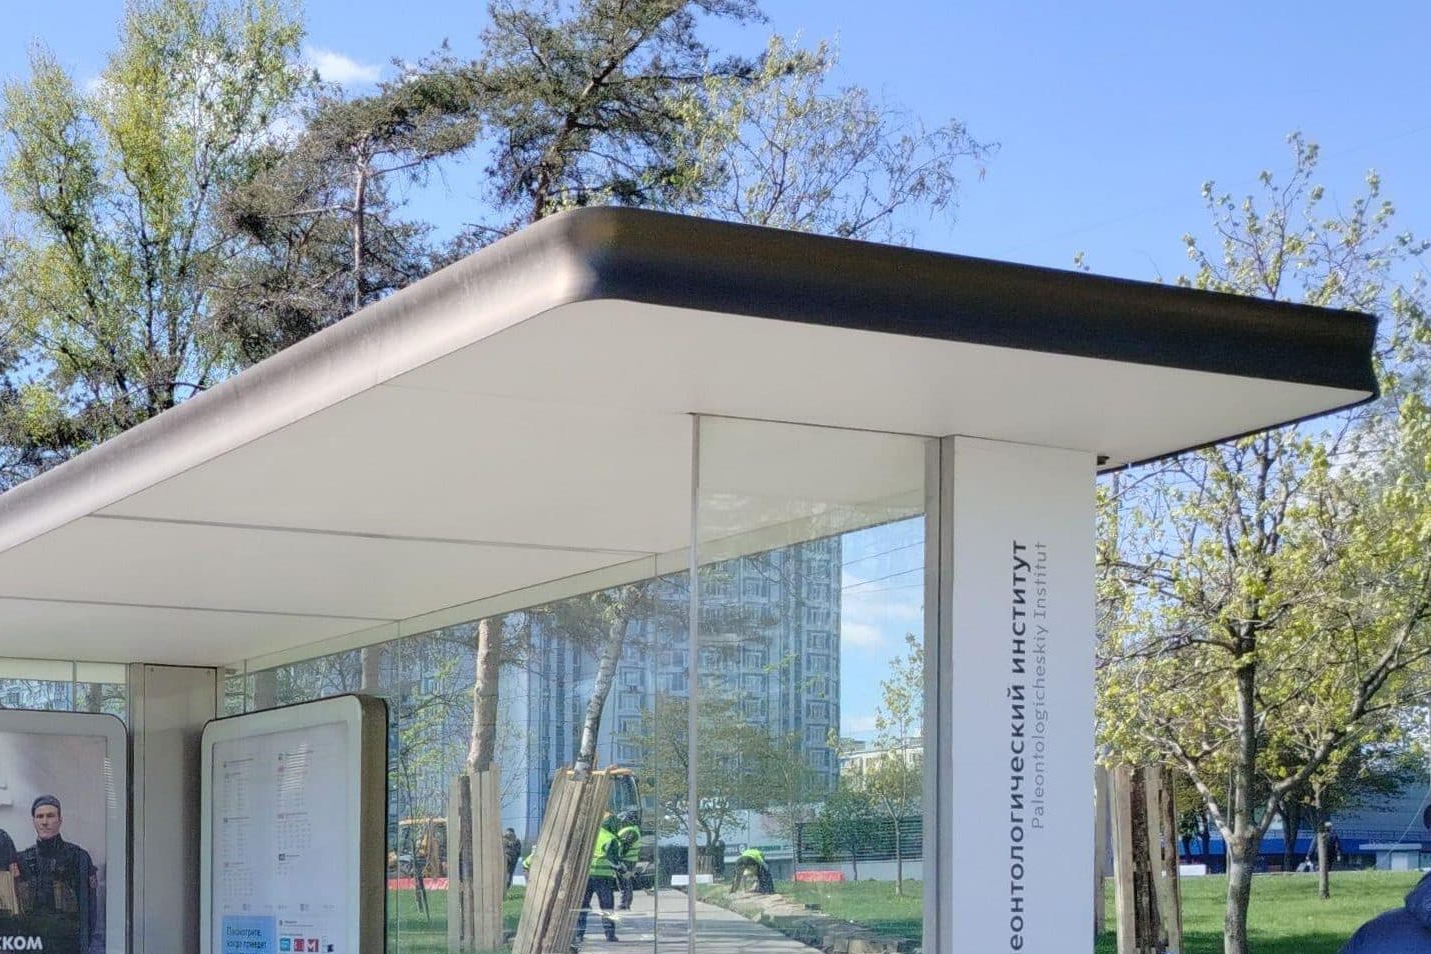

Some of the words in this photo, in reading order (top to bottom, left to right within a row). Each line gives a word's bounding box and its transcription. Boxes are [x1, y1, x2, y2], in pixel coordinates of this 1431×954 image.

[1011, 540, 1032, 674] институт
[1032, 541, 1048, 618] Institut
[1031, 625, 1049, 829] Paleontologicheskiy
